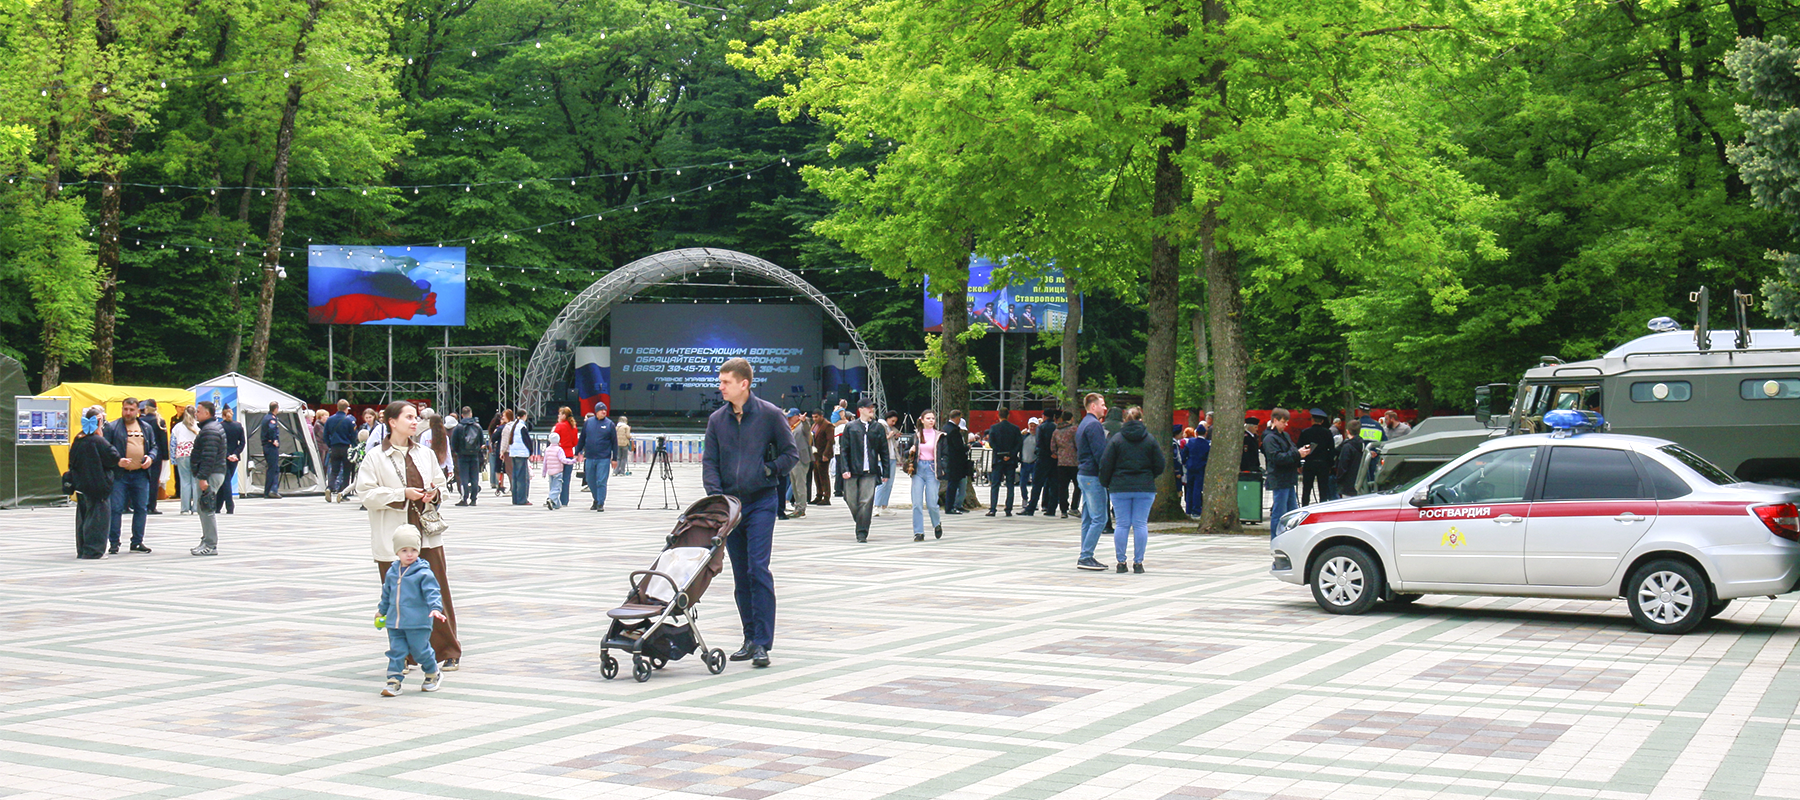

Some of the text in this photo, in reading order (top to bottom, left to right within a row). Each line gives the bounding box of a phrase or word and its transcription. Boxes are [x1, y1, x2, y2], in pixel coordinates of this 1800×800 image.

[636, 347, 663, 355] ВСЕМ
[665, 347, 747, 356] ИНТЕРЕСУЮЩИМ
[635, 354, 707, 364] ОБРАЩАЙТЕСЬ
[710, 356, 724, 364] ПО
[1419, 507, 1491, 518] РОСГВАРДИЯ
